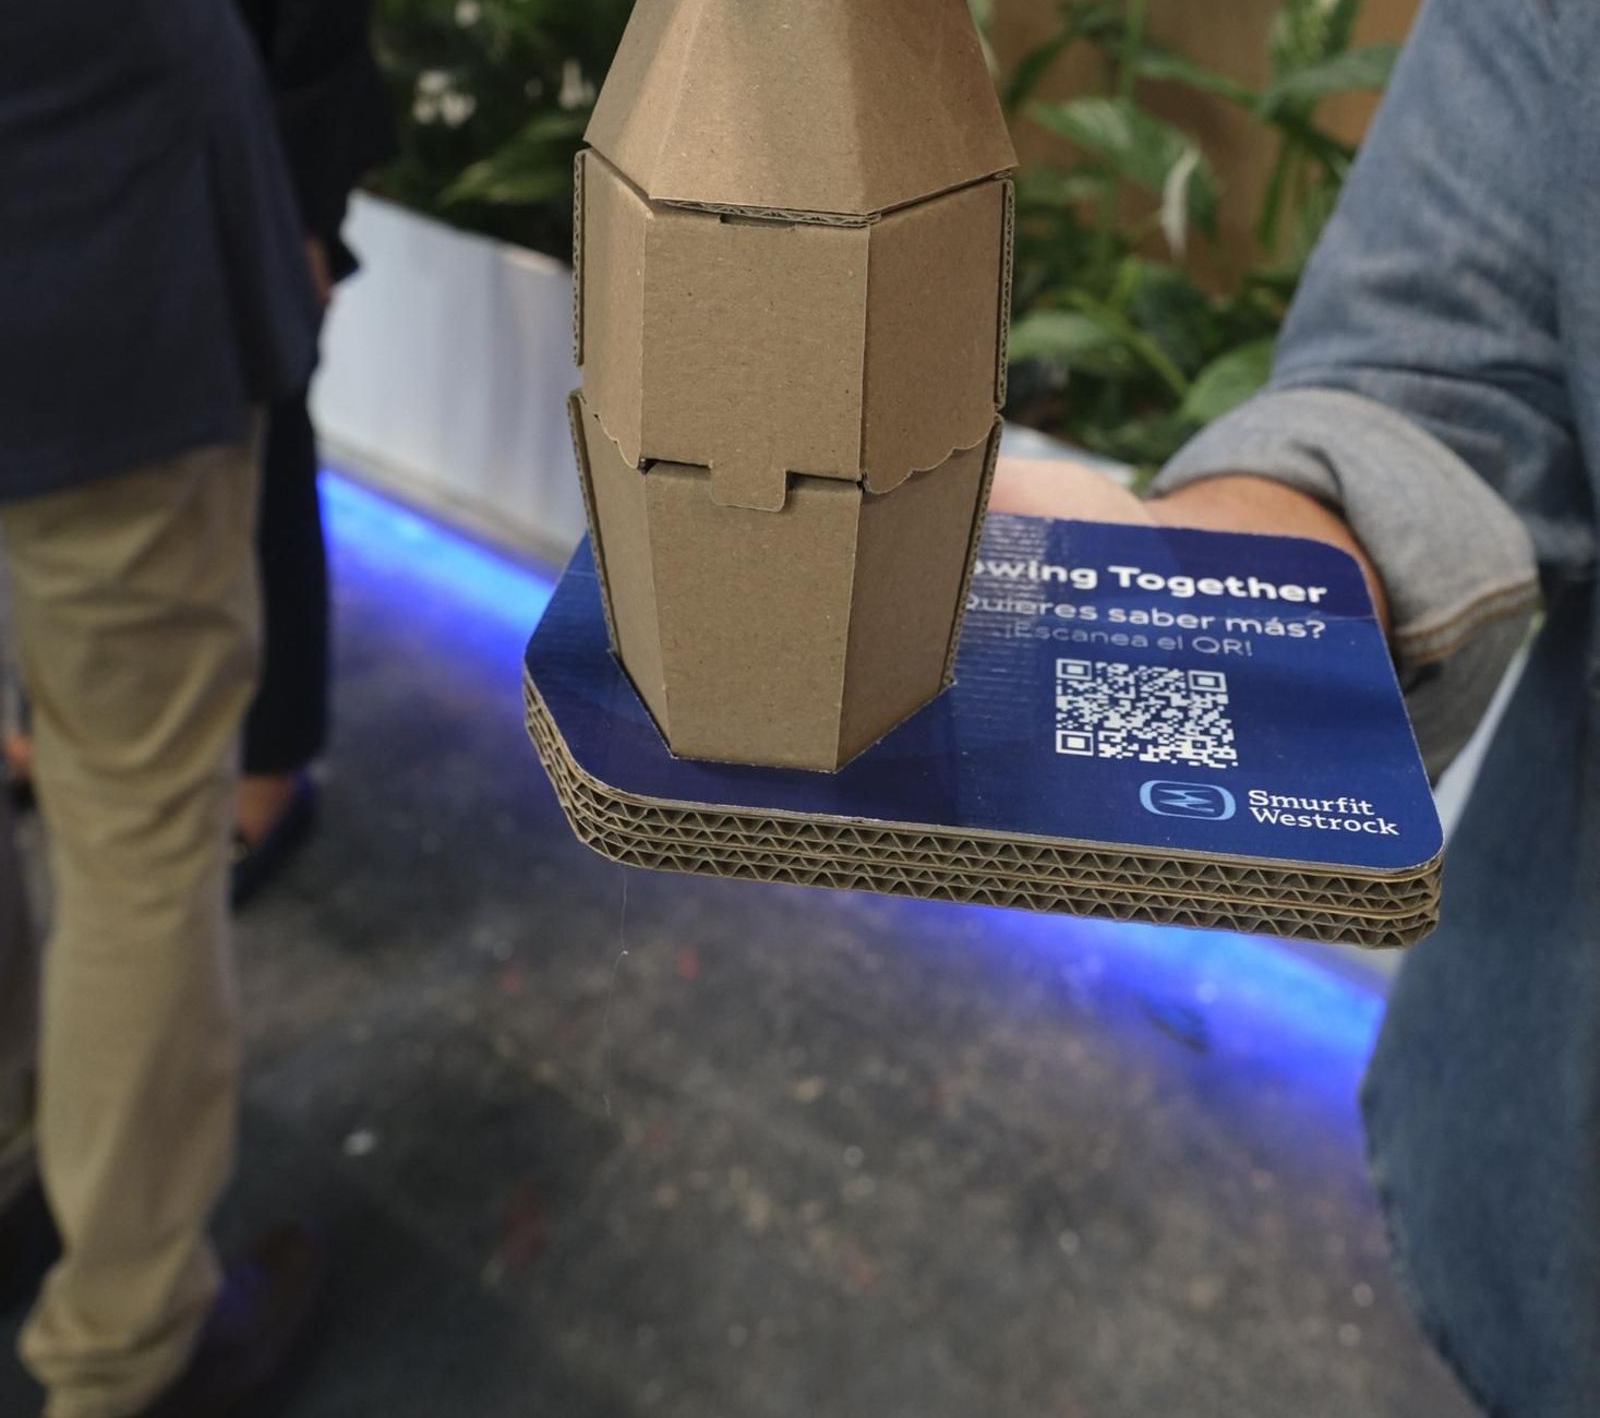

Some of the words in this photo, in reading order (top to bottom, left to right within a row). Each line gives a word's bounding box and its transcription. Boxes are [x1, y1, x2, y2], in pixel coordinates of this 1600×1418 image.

[1107, 565, 1328, 603] Together
[1107, 607, 1216, 631] saber
[1225, 616, 1327, 639] más?
[1157, 635, 1184, 650] el
[1191, 635, 1254, 657] QR!
[1247, 789, 1376, 816] Smurfit
[1248, 806, 1400, 836] Westrock
